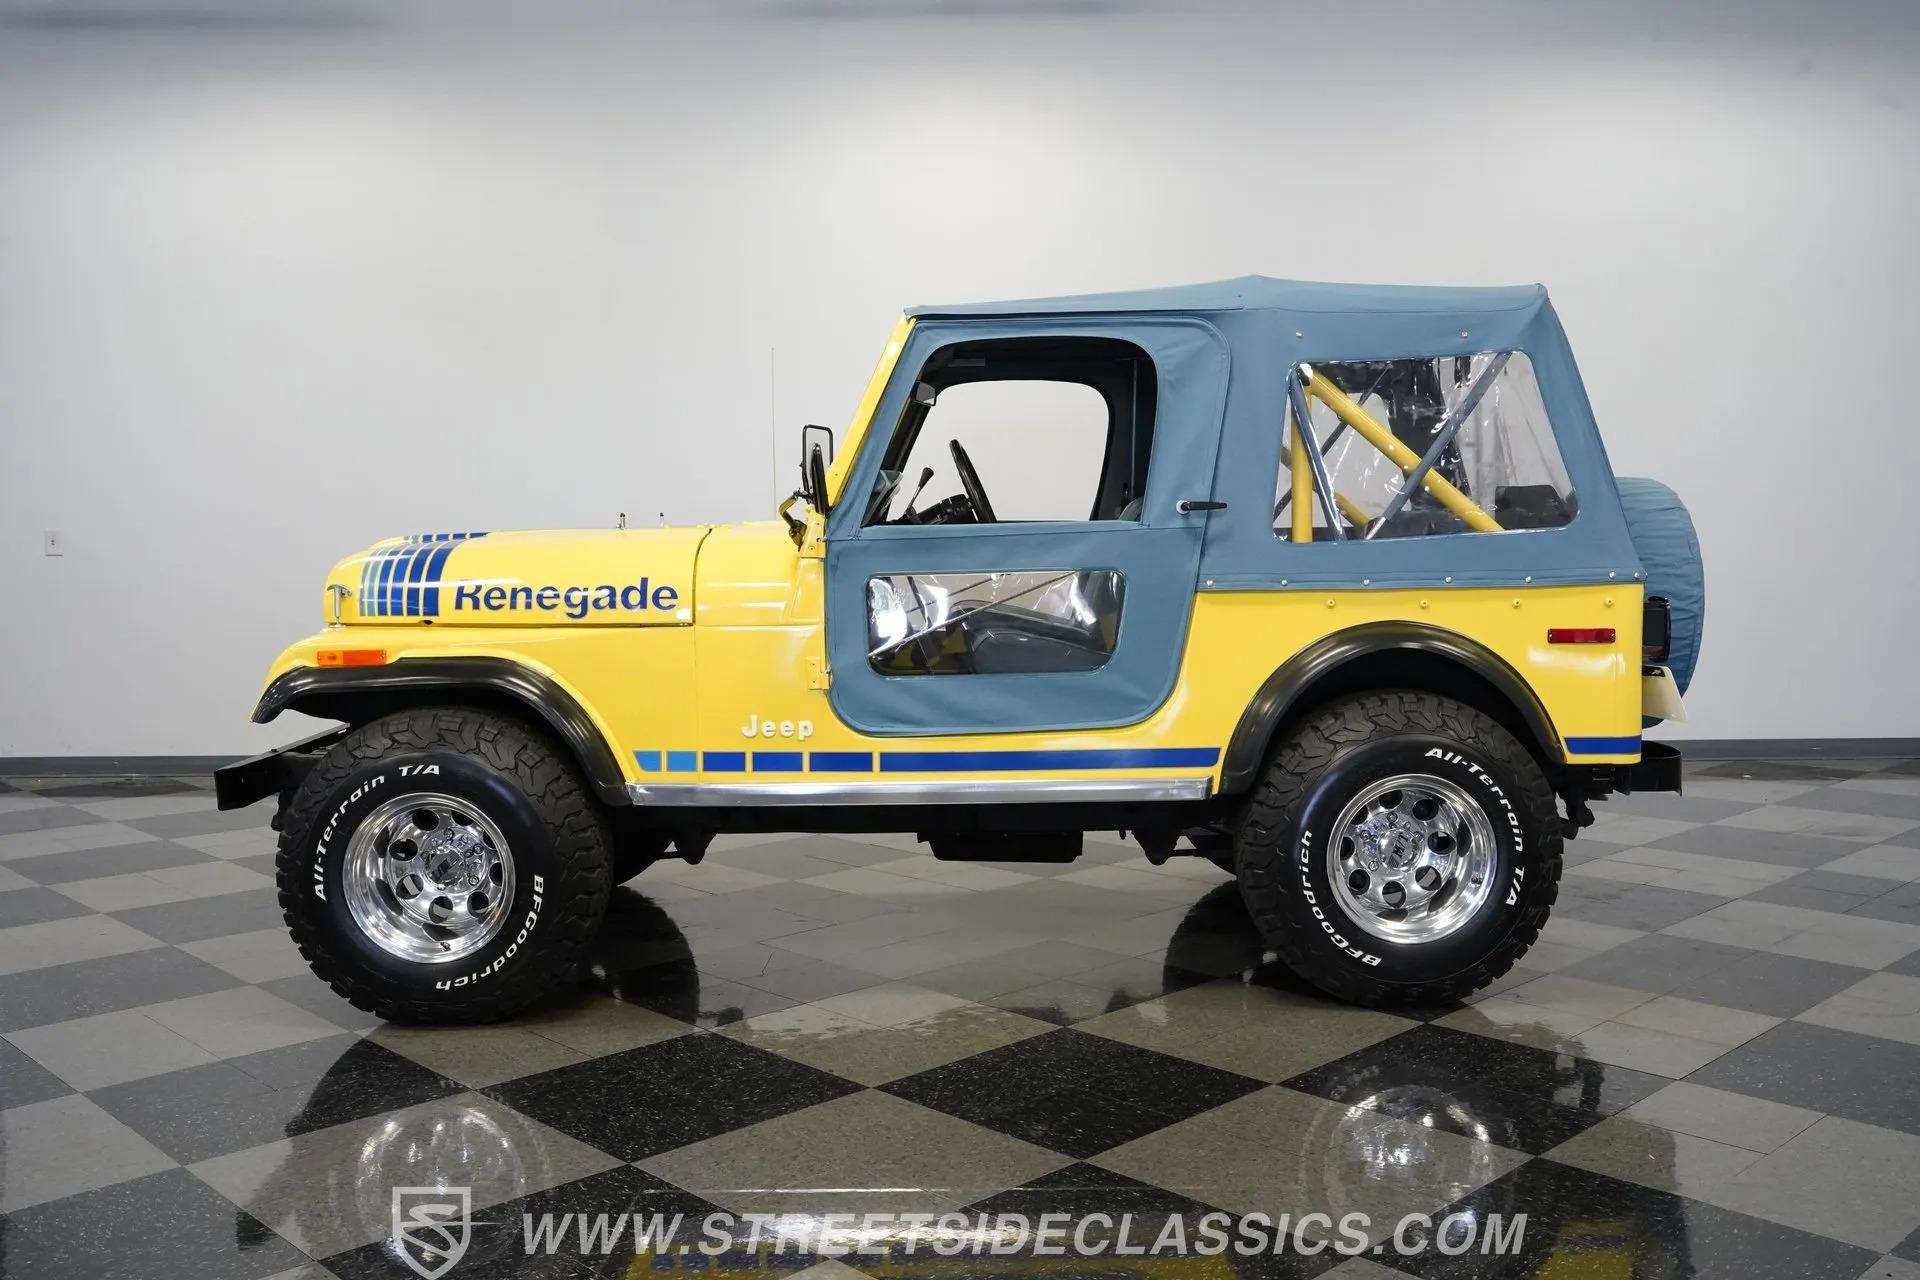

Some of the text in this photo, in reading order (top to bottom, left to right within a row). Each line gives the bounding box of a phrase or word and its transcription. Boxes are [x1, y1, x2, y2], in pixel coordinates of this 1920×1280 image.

[455, 577, 678, 619] Renegade
[741, 715, 814, 740] Jeep
[313, 764, 440, 901] All-Terrain T/A
[1424, 747, 1526, 906] All-Terrain T/A
[435, 874, 544, 991] BFGoodrich
[1298, 830, 1382, 967] BFGoodrich
